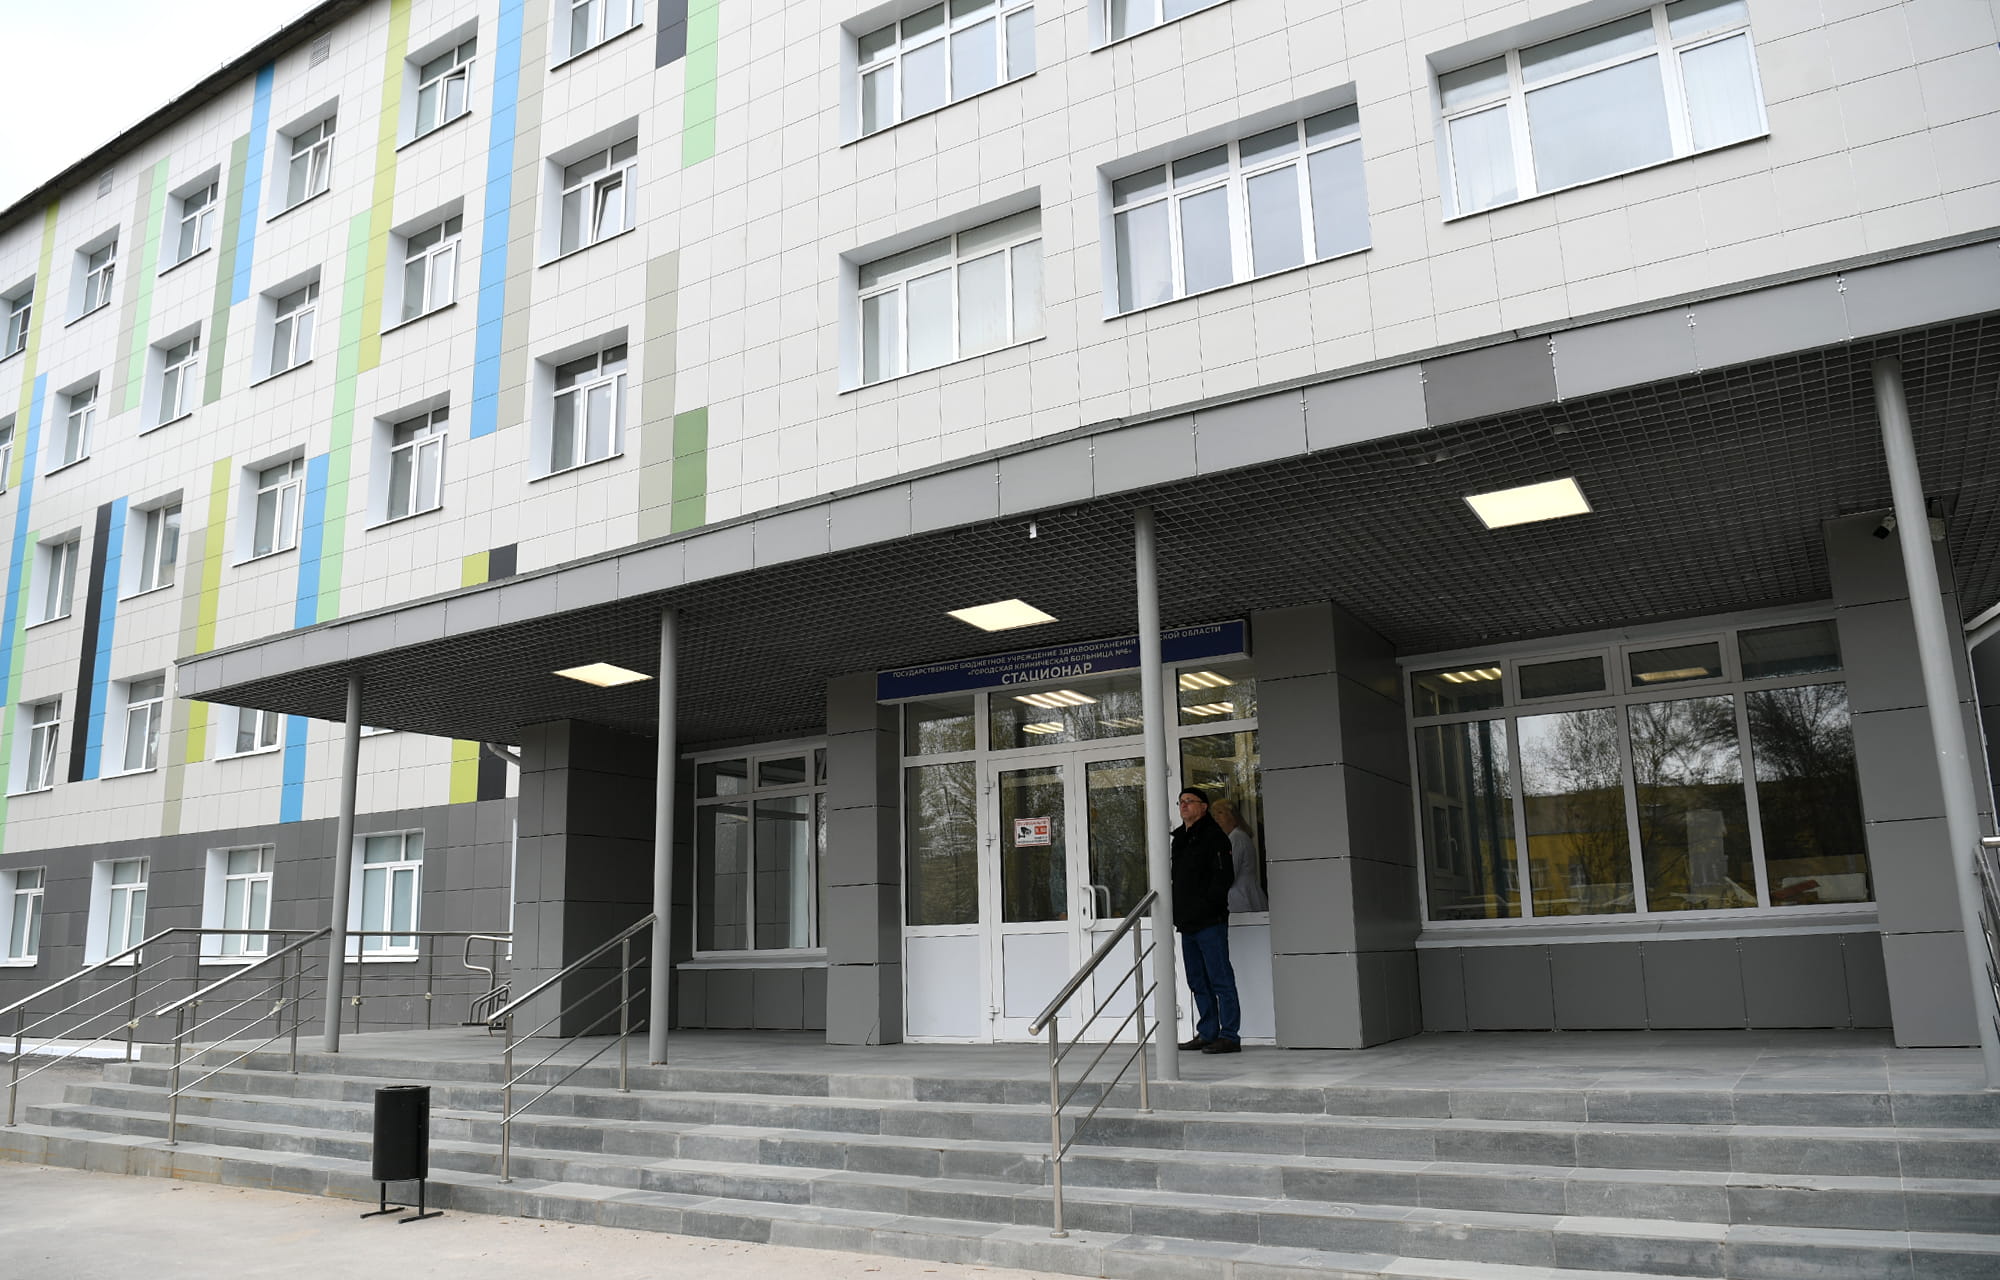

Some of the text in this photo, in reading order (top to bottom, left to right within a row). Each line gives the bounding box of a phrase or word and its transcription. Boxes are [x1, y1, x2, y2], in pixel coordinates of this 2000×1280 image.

[893, 664, 959, 678] ГОСУДАРСТВЕННОЕ
[960, 656, 1006, 669] БЮДЖЕТНОЕ
[1008, 650, 1056, 664] УЧРЕЖДЕНИЕ
[1059, 639, 1136, 656] ЗДРАВООХРАНЕНИЯ
[1182, 626, 1221, 638] ОБЛАСТИ
[1014, 657, 1069, 670] КЛИНИЧЕСКАЯ
[1071, 651, 1114, 662] БОЛЬНИЦА
[1001, 662, 1093, 684] СТАЦИОНАР
